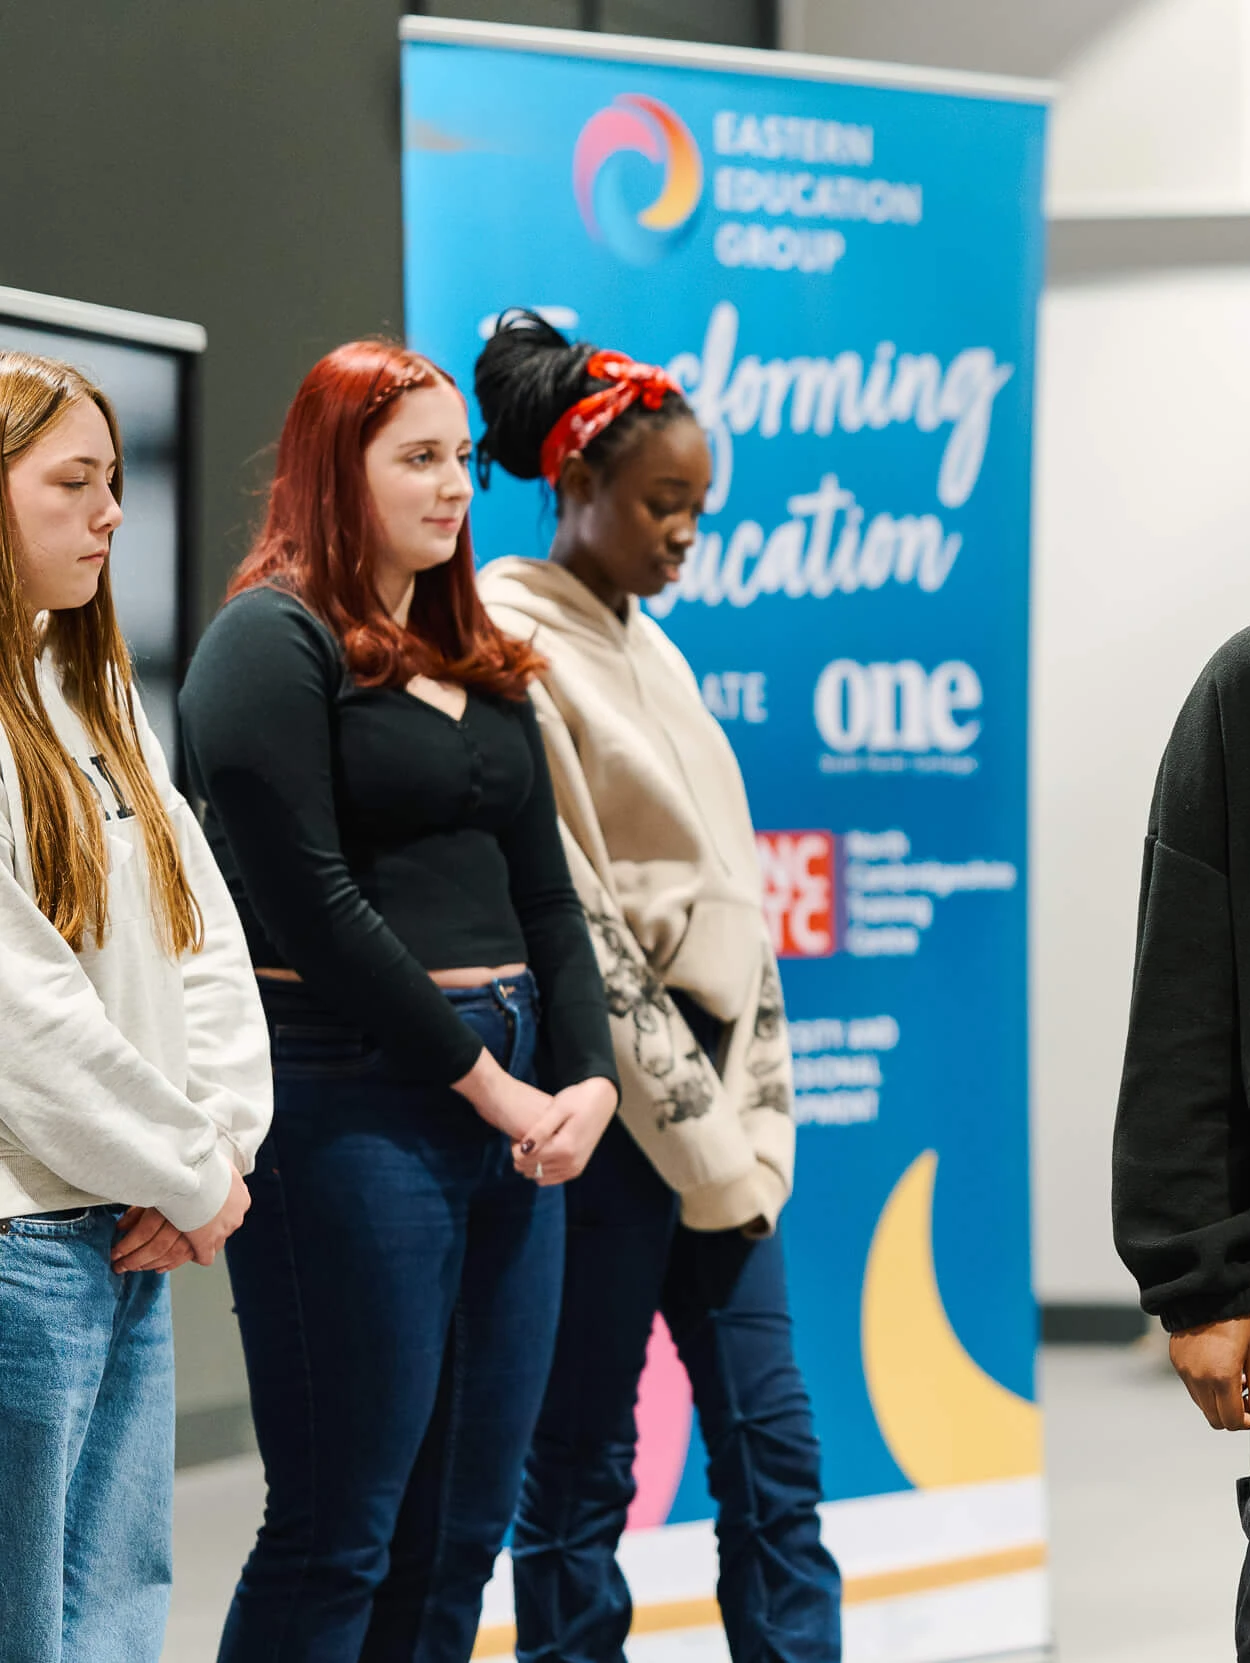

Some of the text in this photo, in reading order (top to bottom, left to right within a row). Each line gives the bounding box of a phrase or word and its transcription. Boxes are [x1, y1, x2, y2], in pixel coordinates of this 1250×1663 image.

[713, 110, 873, 165] EASTERN
[713, 167, 922, 225] EDUCATION
[713, 222, 845, 272] GROUP
[480, 301, 1014, 515] forming
[645, 473, 962, 618] ucation
[813, 658, 983, 752] one
